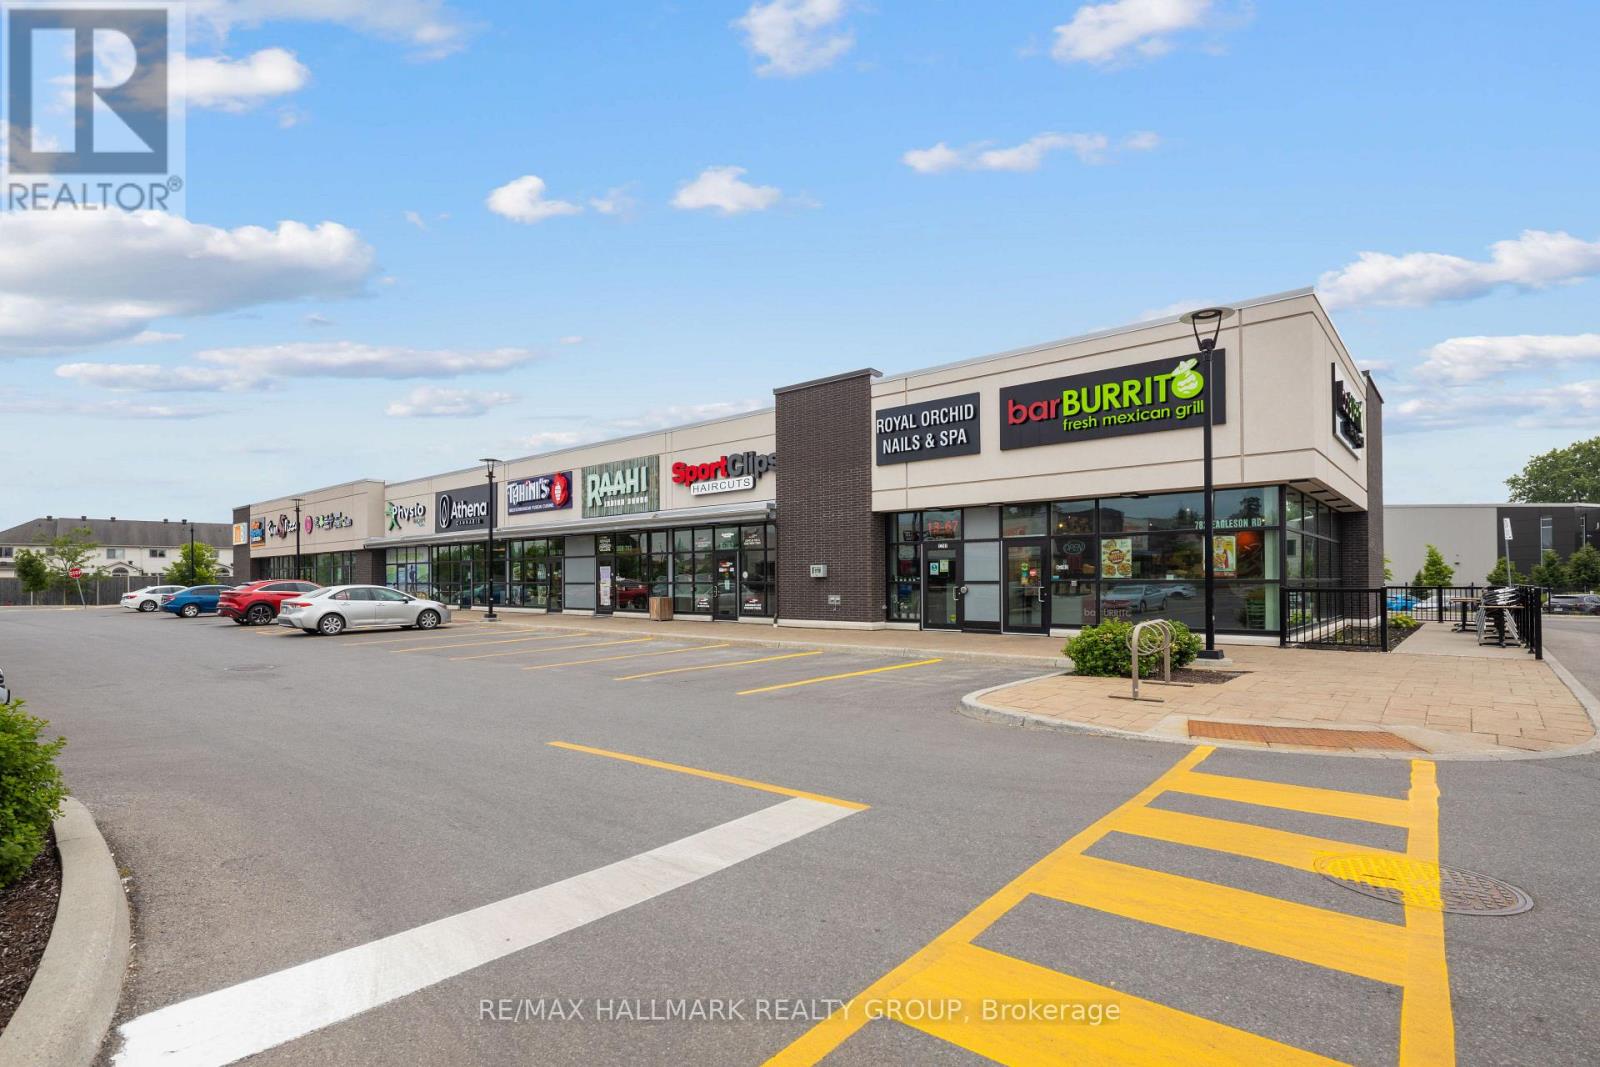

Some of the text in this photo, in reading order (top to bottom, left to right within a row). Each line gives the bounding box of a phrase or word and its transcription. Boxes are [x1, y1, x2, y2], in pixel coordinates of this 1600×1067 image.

[876, 404, 974, 434] ROYAL ORCHID
[1063, 400, 1204, 431] fresh mexican grill
[883, 429, 967, 454] NAILS & SPA
[587, 466, 647, 507] RAAHI
[692, 478, 751, 494] HAIRCUTS
[393, 504, 424, 520] Physio
[451, 500, 487, 519] Athena
